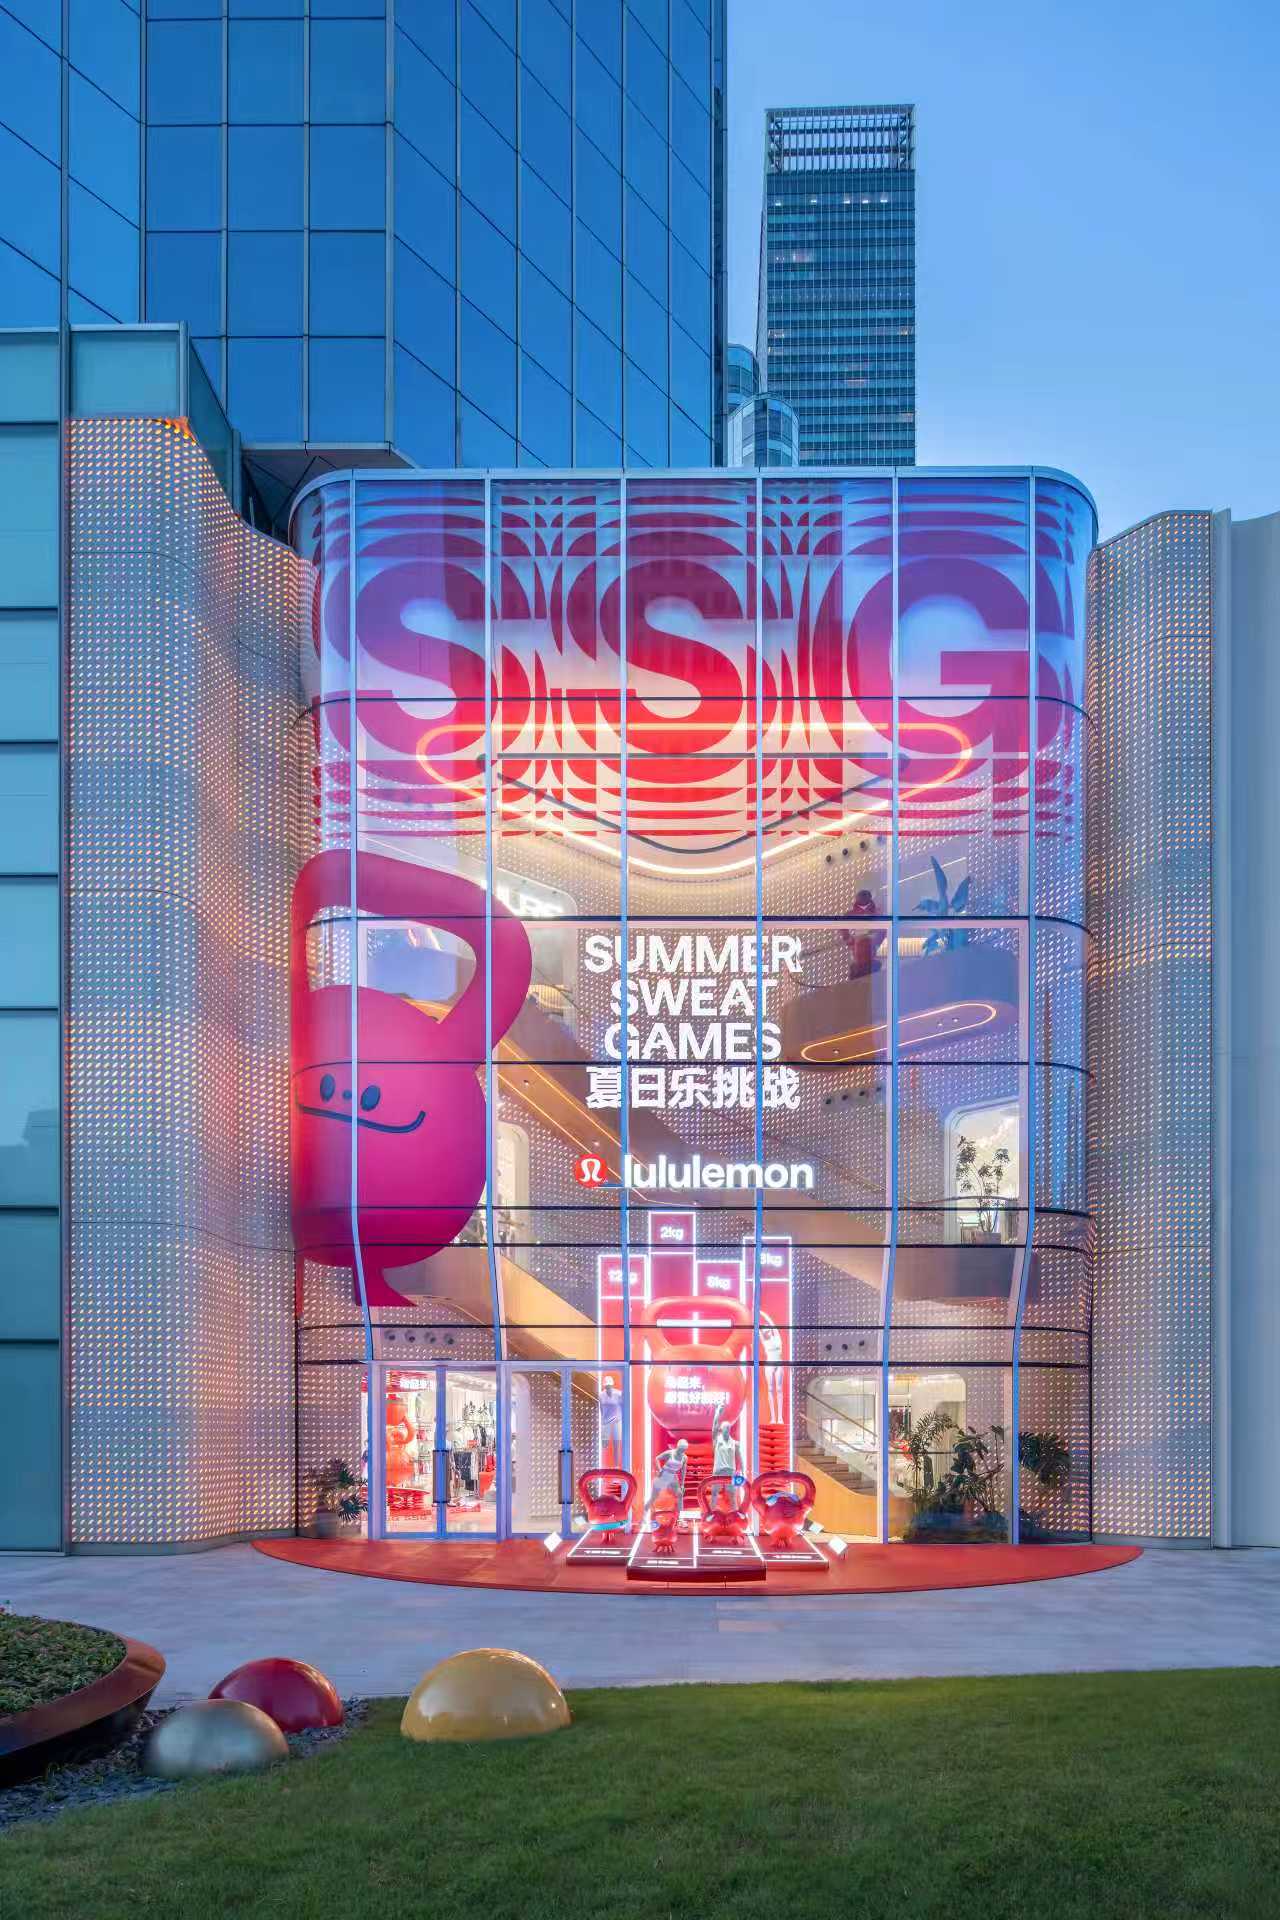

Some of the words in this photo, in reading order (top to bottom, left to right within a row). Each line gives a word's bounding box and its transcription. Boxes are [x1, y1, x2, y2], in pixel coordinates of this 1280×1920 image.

[584, 935, 803, 973] SUMMER
[610, 978, 778, 1016] SWEAT
[604, 1022, 782, 1060] GAMES
[585, 1066, 801, 1109] 夏日乐挑战
[624, 1154, 814, 1189] lululemon
[607, 1269, 638, 1285] 12g
